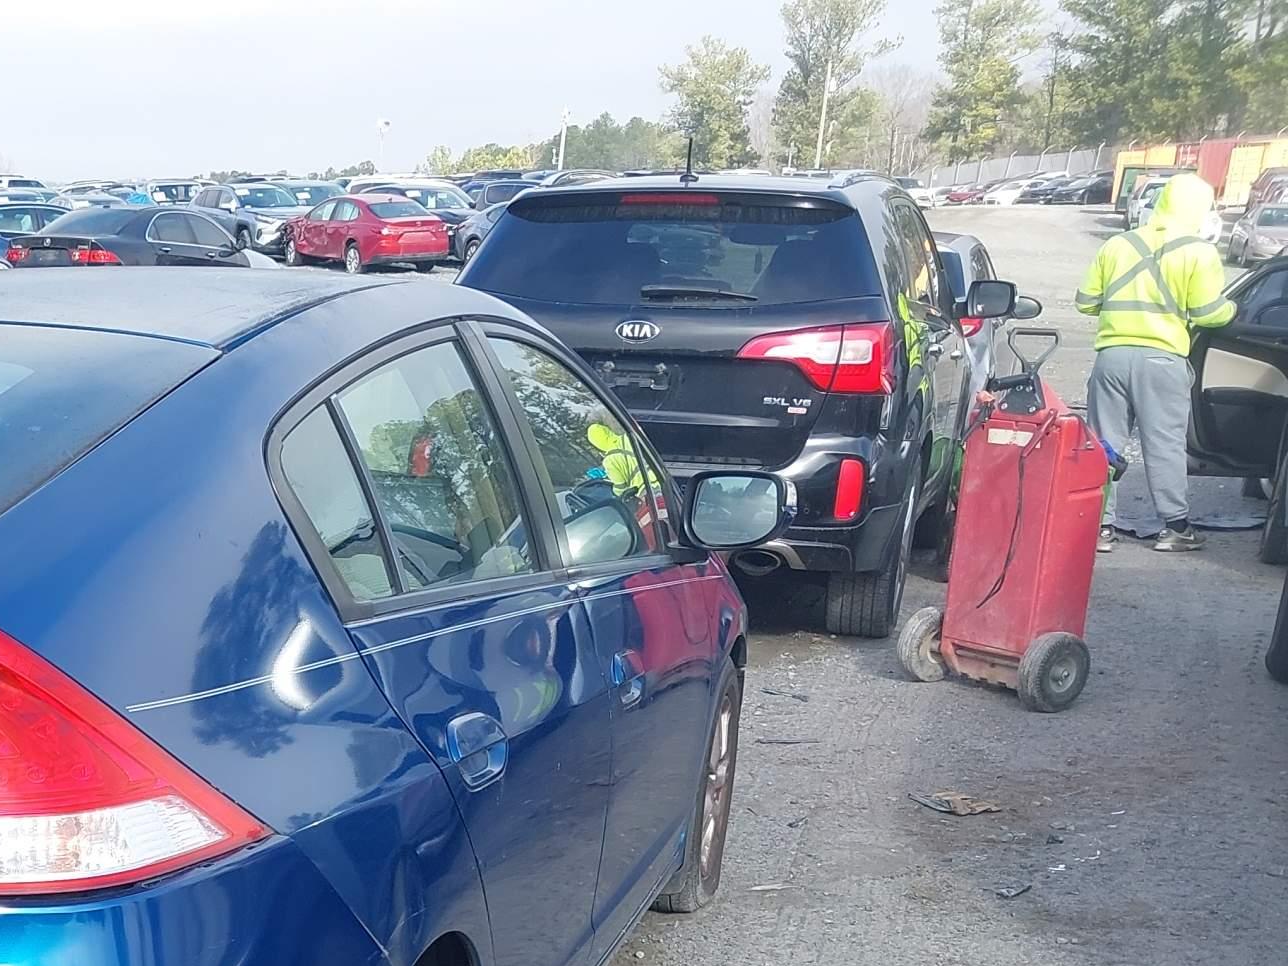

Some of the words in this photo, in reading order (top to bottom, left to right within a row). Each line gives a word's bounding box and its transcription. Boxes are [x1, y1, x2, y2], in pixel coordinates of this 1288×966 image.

[622, 324, 652, 338] KIA
[763, 397, 790, 406] SXL
[793, 398, 812, 407] V6
